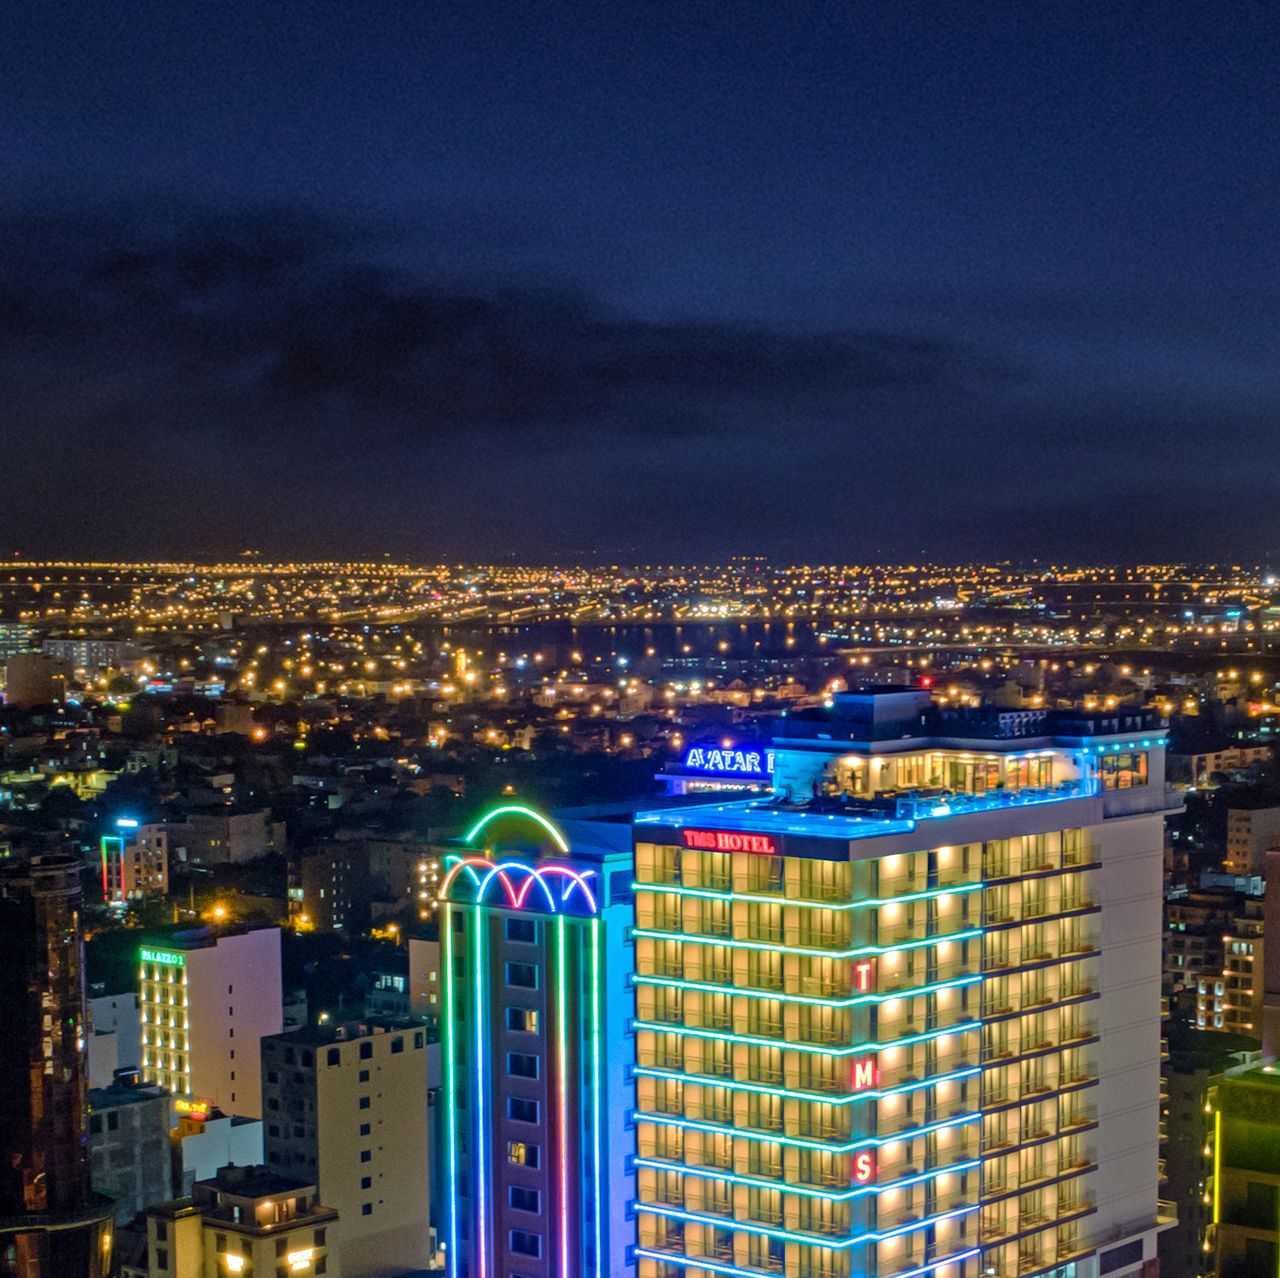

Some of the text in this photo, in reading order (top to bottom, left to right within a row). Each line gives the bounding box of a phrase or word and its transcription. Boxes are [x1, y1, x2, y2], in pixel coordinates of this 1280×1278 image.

[686, 748, 762, 773] AVATAR
[684, 830, 775, 854] TMS HOTEL
